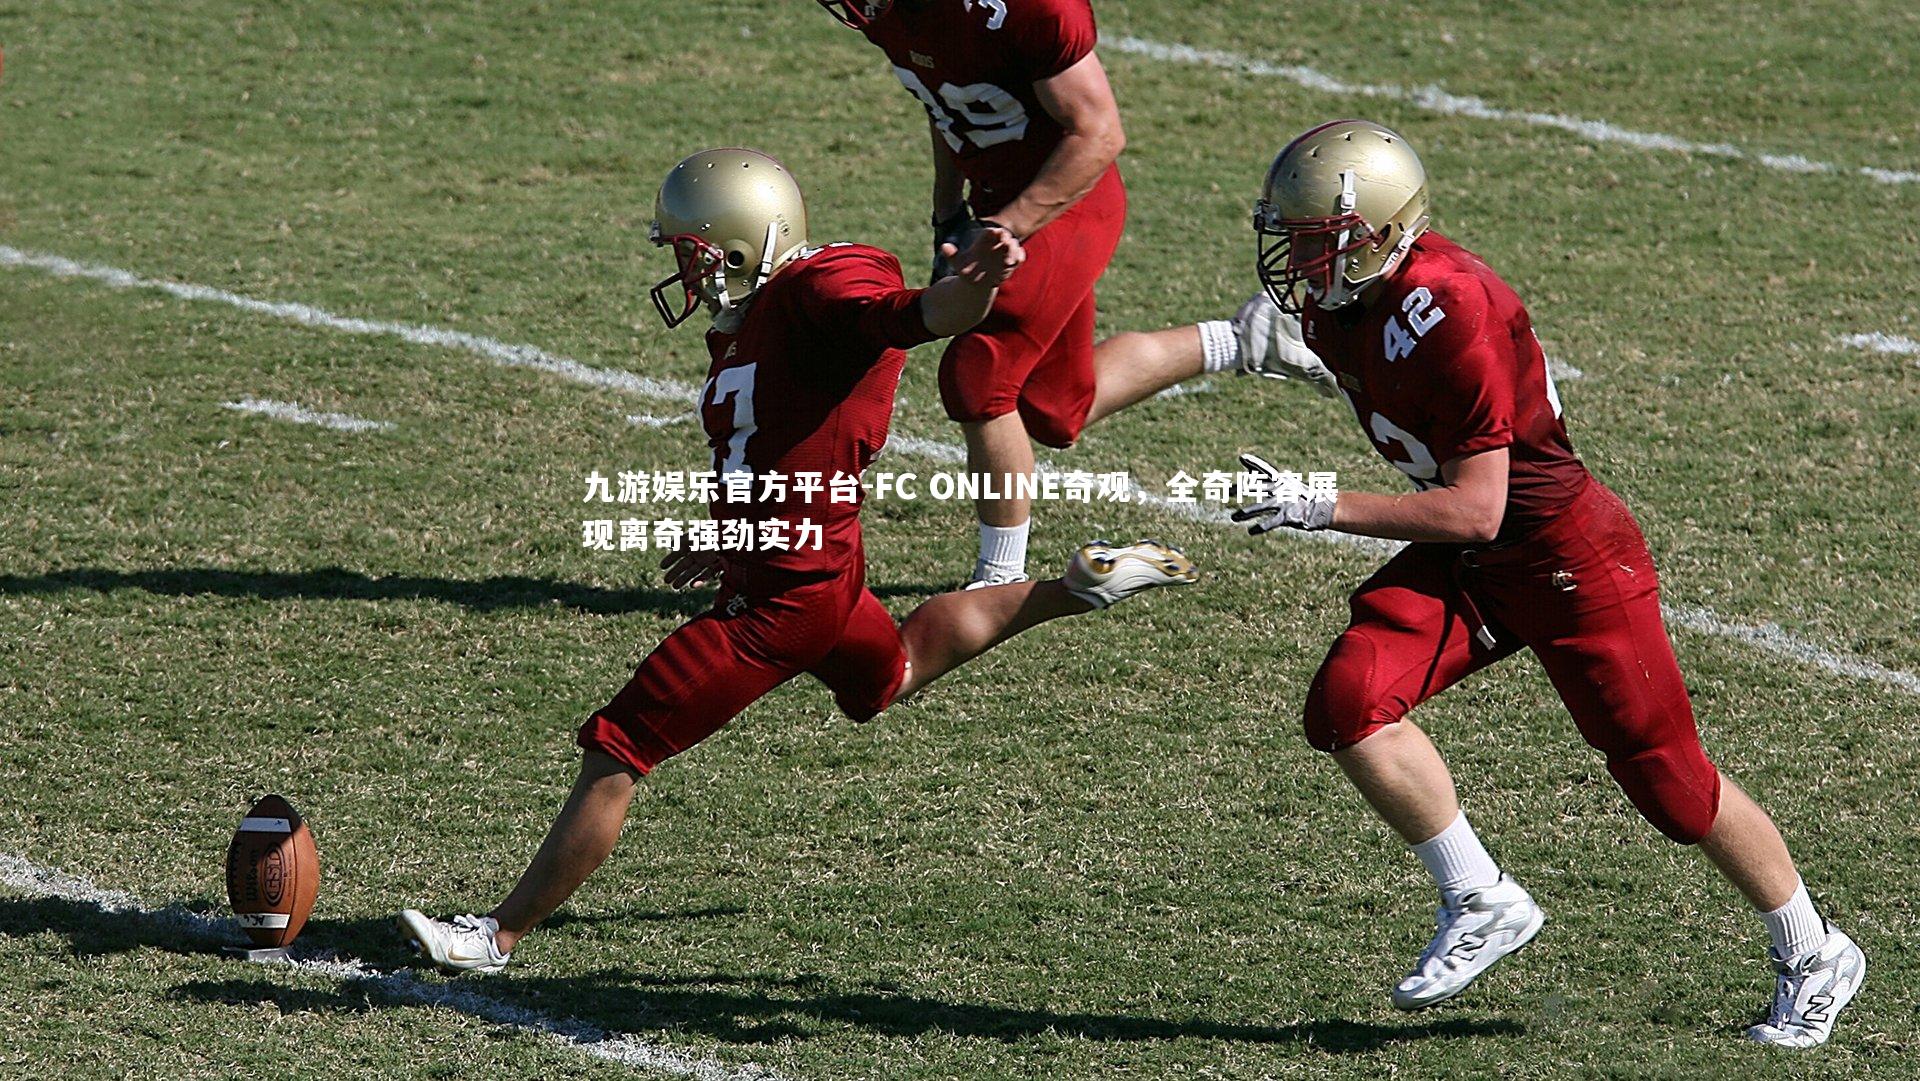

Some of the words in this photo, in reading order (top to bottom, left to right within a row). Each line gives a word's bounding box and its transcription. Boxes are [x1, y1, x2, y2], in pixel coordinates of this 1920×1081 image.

[1383, 286, 1446, 362] 42
[698, 362, 758, 490] 7
[1340, 387, 1442, 492] 2
